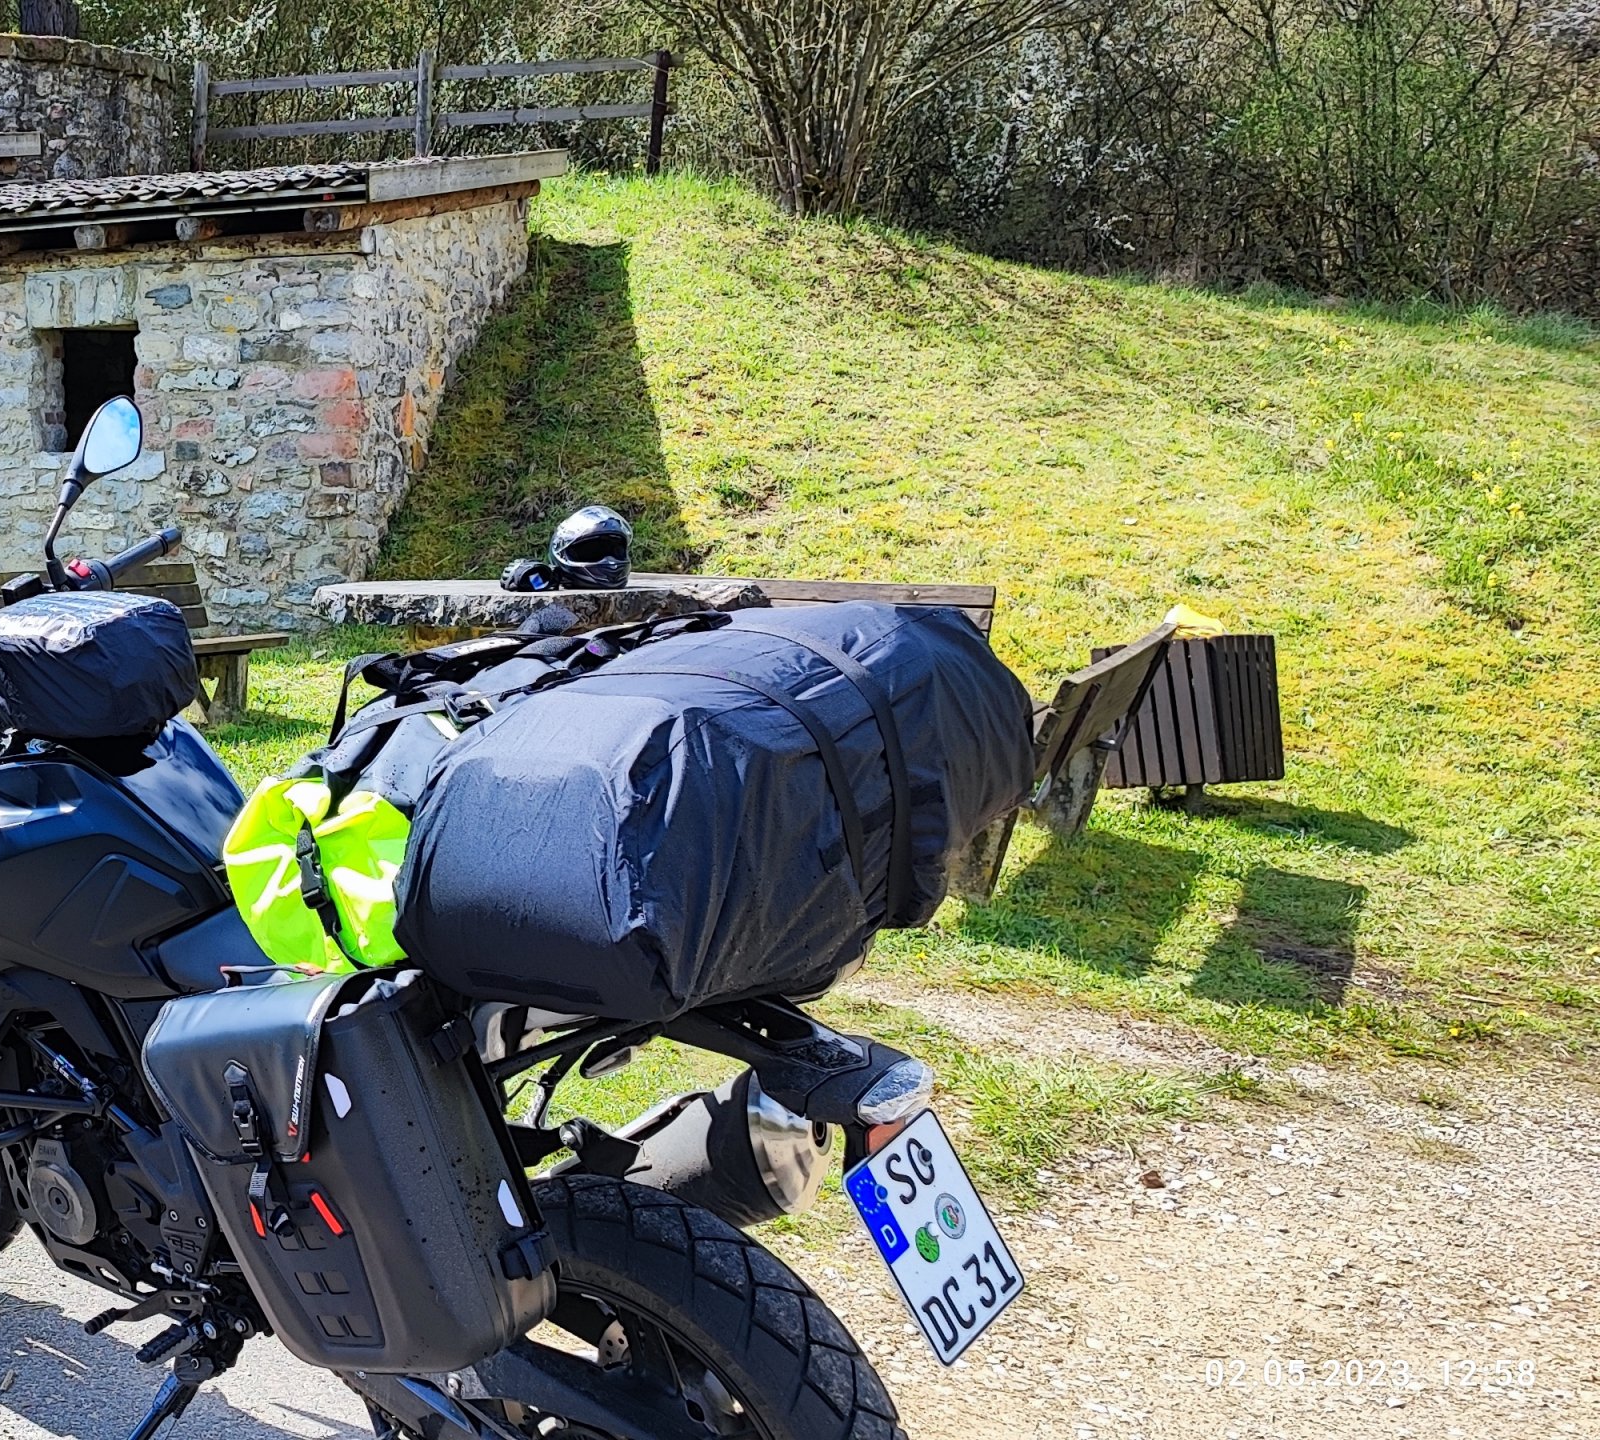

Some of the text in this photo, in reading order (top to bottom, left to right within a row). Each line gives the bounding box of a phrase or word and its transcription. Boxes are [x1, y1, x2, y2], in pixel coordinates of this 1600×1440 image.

[291, 1054, 305, 1125] SW-MOTECH
[885, 1137, 936, 1205] SO
[880, 1224, 898, 1249] D
[921, 1240, 1017, 1352] DC 31
